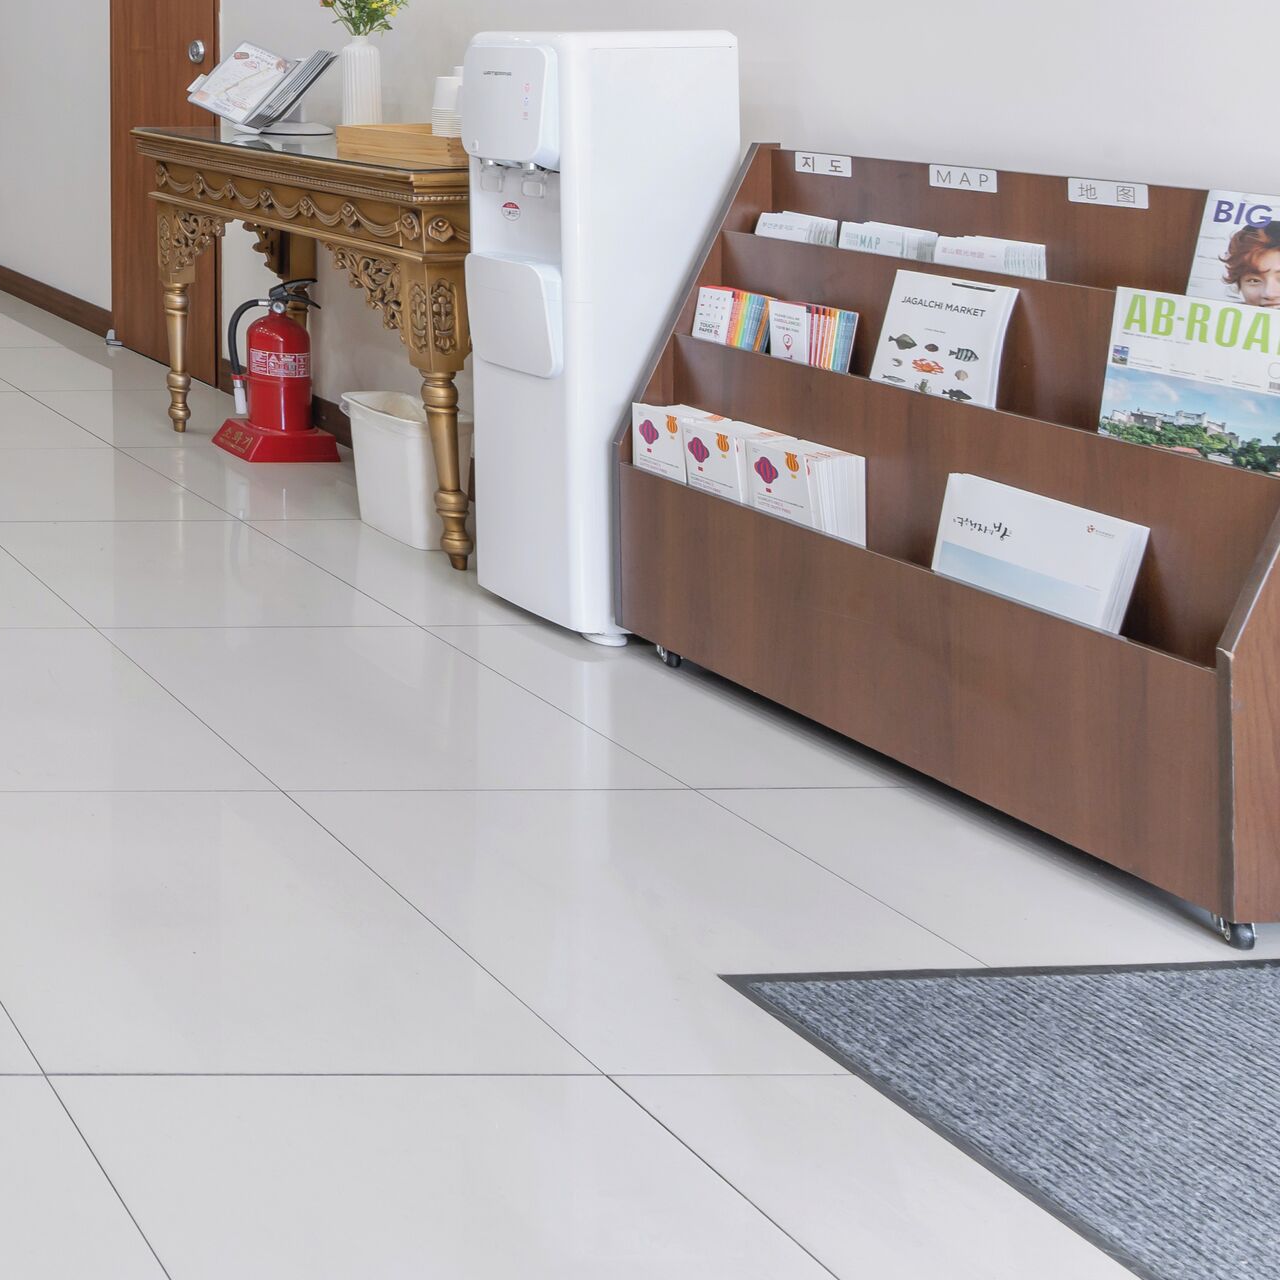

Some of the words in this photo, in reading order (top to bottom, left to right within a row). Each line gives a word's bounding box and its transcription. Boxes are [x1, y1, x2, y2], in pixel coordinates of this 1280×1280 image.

[801, 156, 844, 174] 지도
[935, 169, 990, 187] MAP
[1076, 183, 1136, 204] 地图
[1213, 199, 1273, 228] BIG
[860, 233, 880, 250] MAP
[901, 296, 943, 309] JAGALCHI
[944, 303, 986, 317] MARKET
[1123, 294, 1280, 356] AB-ROA
